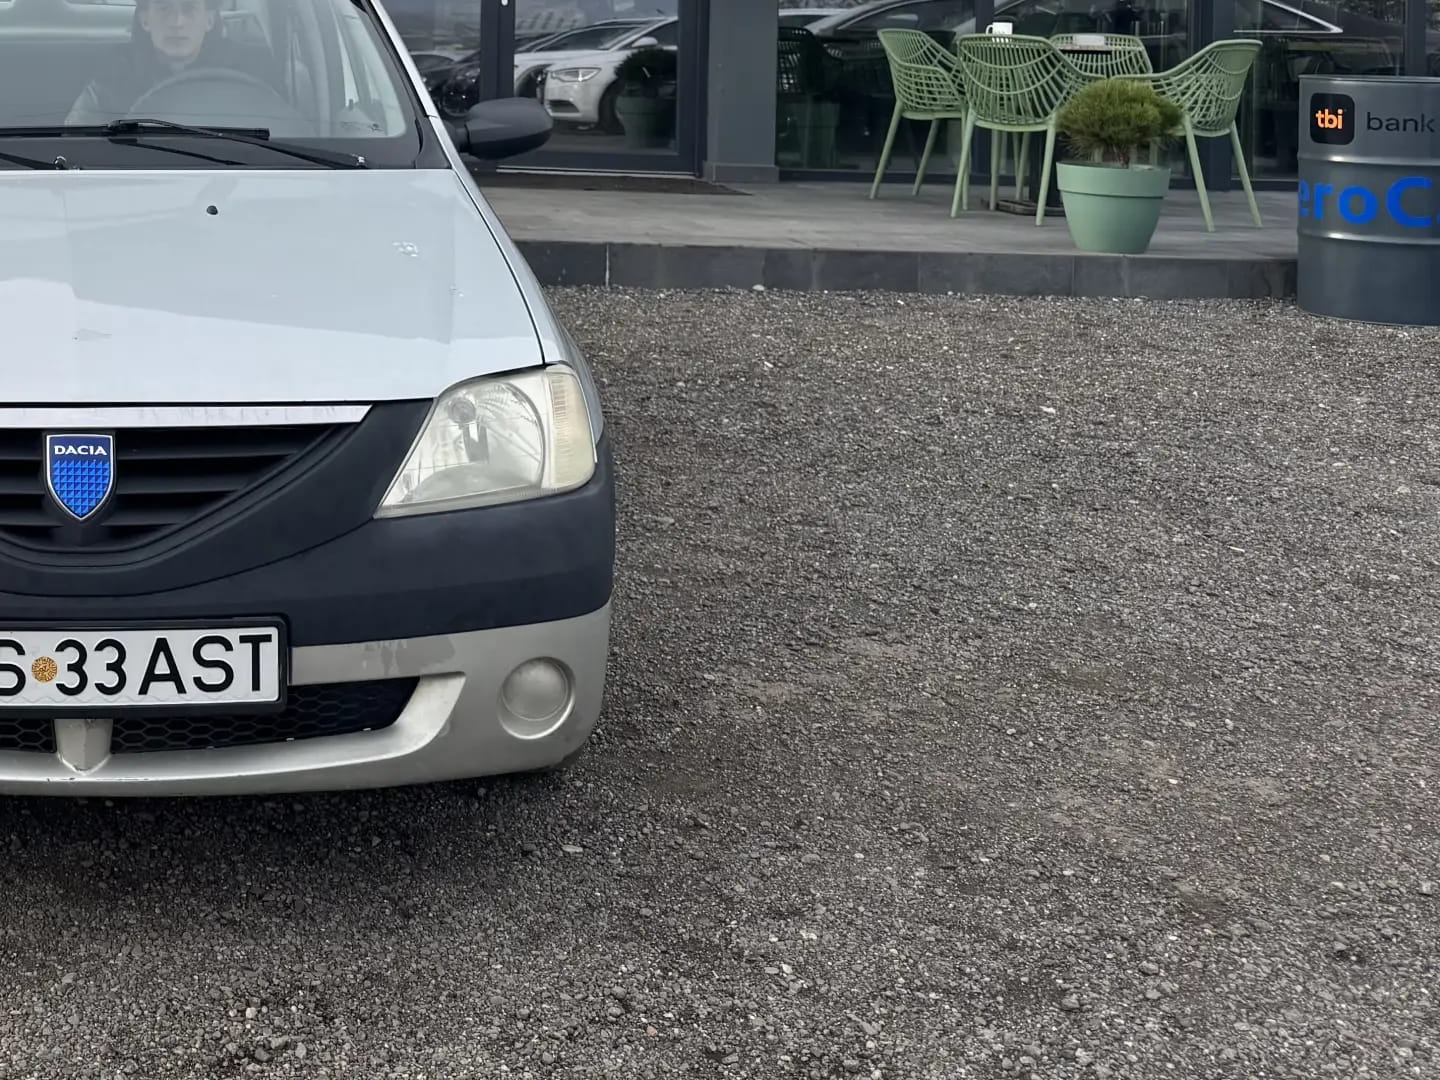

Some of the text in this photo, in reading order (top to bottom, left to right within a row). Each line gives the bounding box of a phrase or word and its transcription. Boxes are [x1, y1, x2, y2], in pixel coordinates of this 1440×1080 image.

[1315, 108, 1435, 133] tbi bank
[53, 445, 108, 456] DACIA
